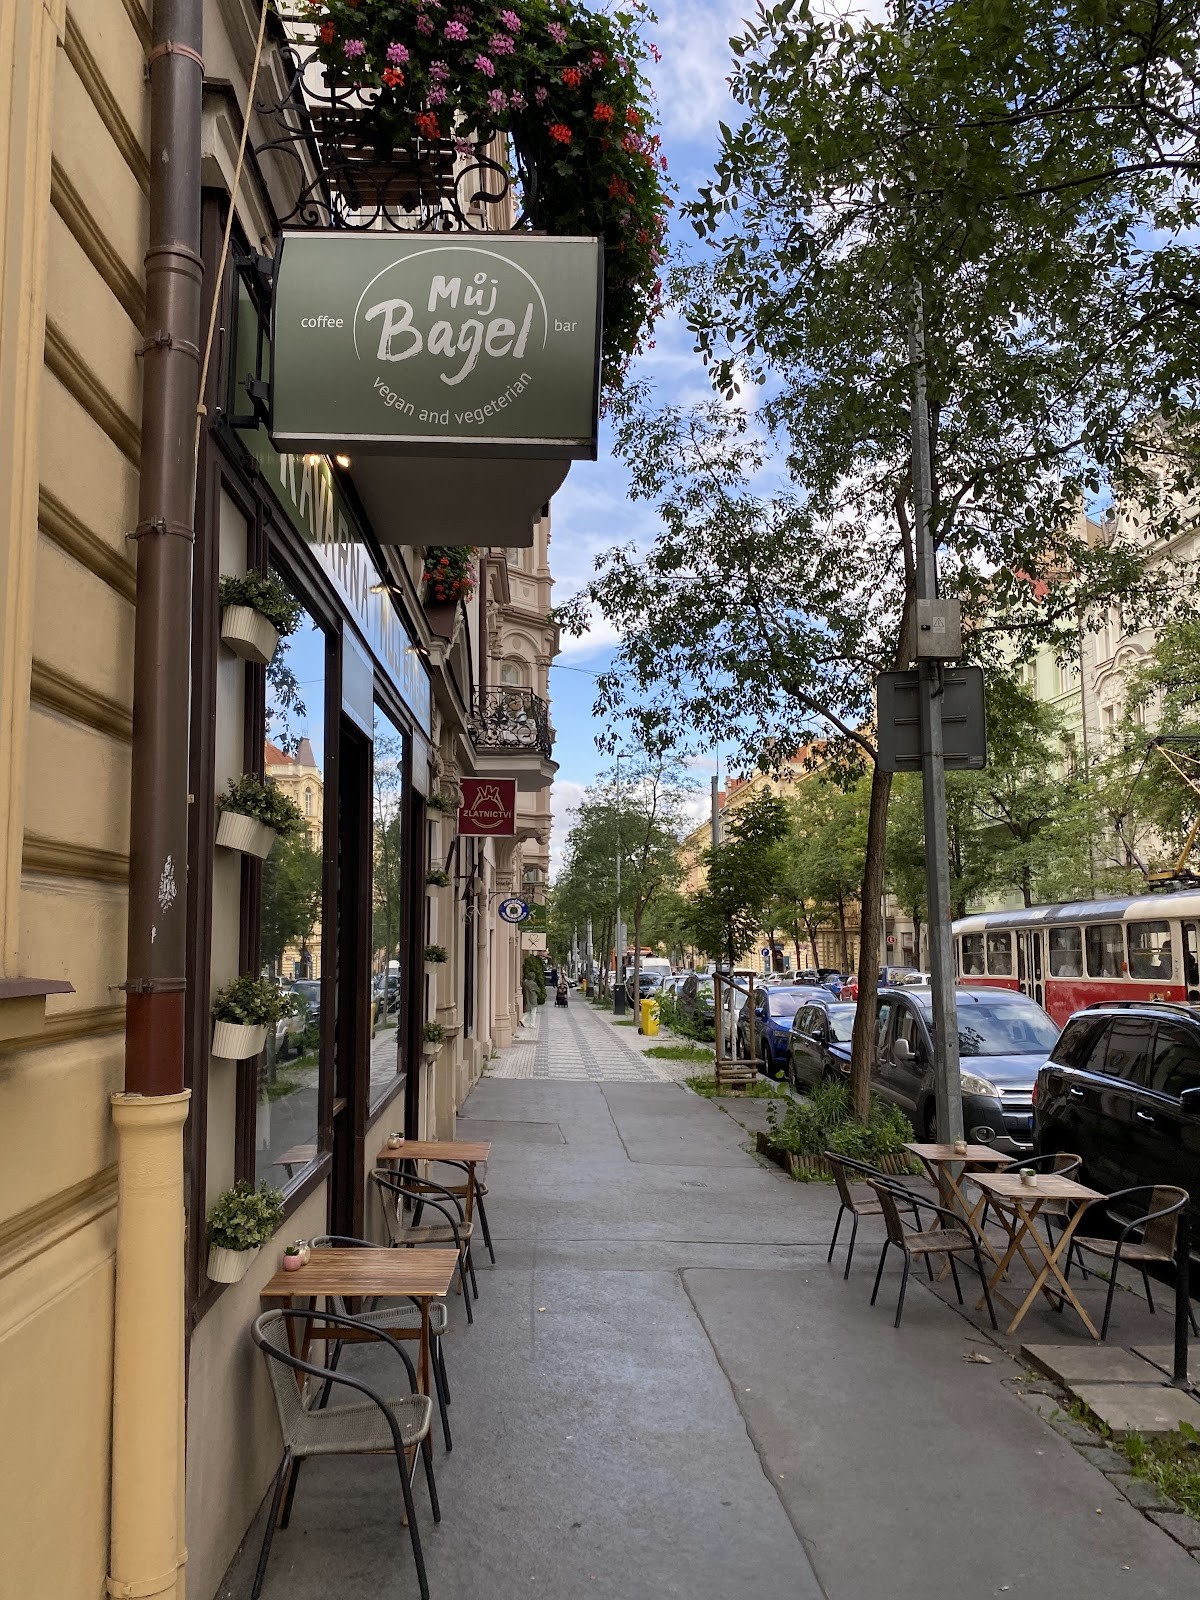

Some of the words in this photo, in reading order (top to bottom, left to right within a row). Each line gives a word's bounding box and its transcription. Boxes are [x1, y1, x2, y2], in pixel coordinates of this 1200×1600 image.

[427, 272, 498, 316] Můj
[301, 315, 344, 328] coffee
[554, 319, 577, 332] bar
[364, 298, 534, 386] Bagel
[373, 376, 416, 416] vegan
[418, 409, 449, 425] and
[454, 372, 532, 425] vegeterian
[463, 810, 513, 819] ZLATNICTVÍ
